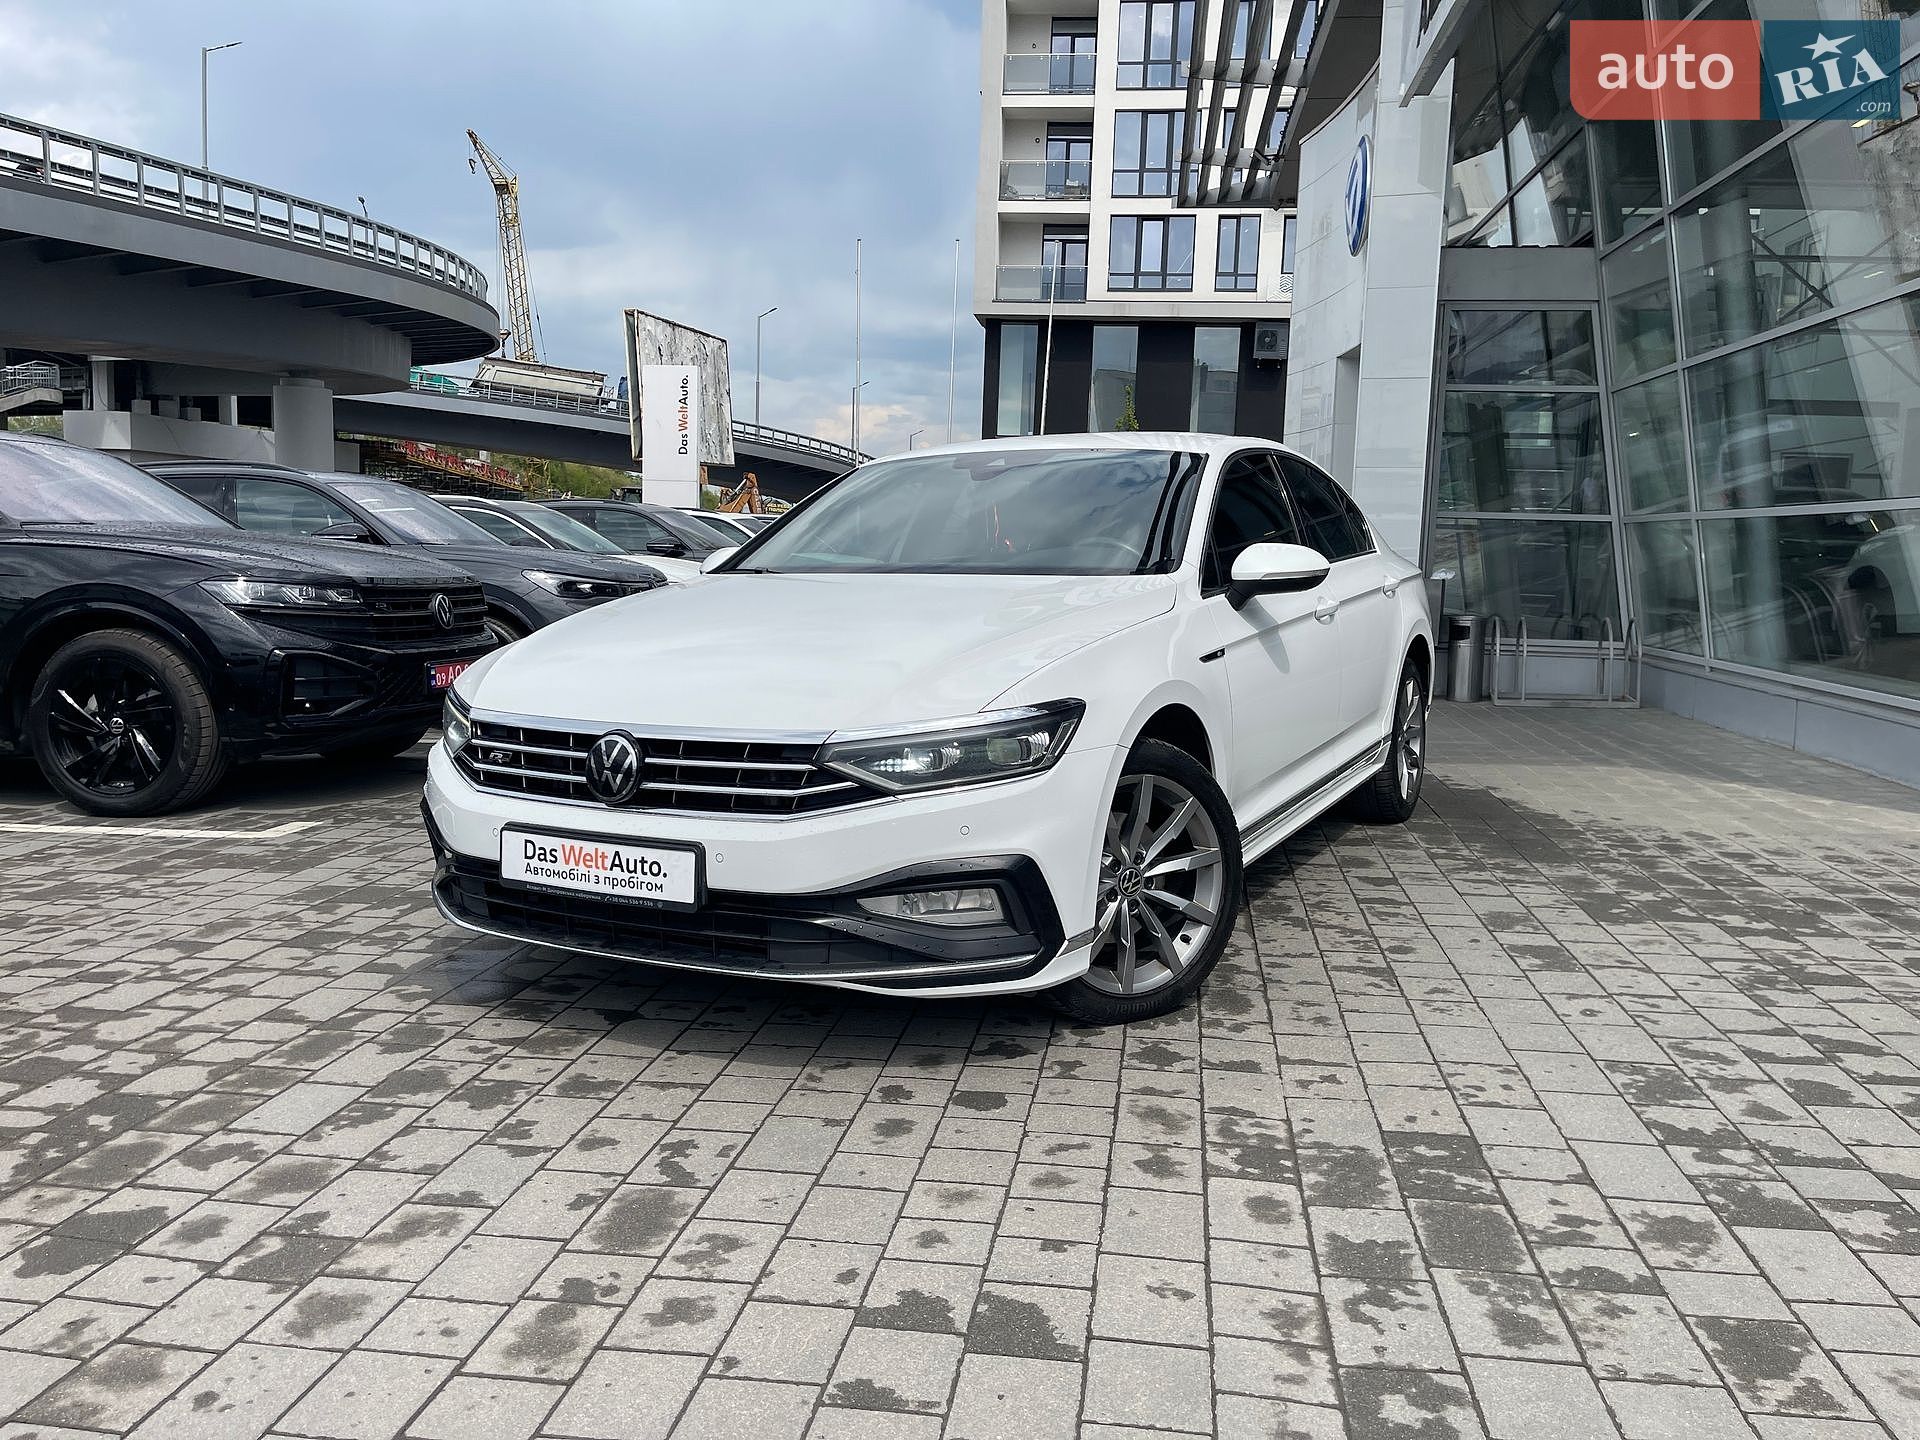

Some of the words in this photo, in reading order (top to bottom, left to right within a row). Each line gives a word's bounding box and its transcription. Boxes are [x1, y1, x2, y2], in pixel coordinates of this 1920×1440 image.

[678, 433, 688, 455] Das
[436, 673, 446, 685] 09
[524, 839, 558, 864] Das
[524, 862, 591, 883] Автомобілі
[593, 875, 600, 885] з
[603, 876, 664, 893] пробігом
